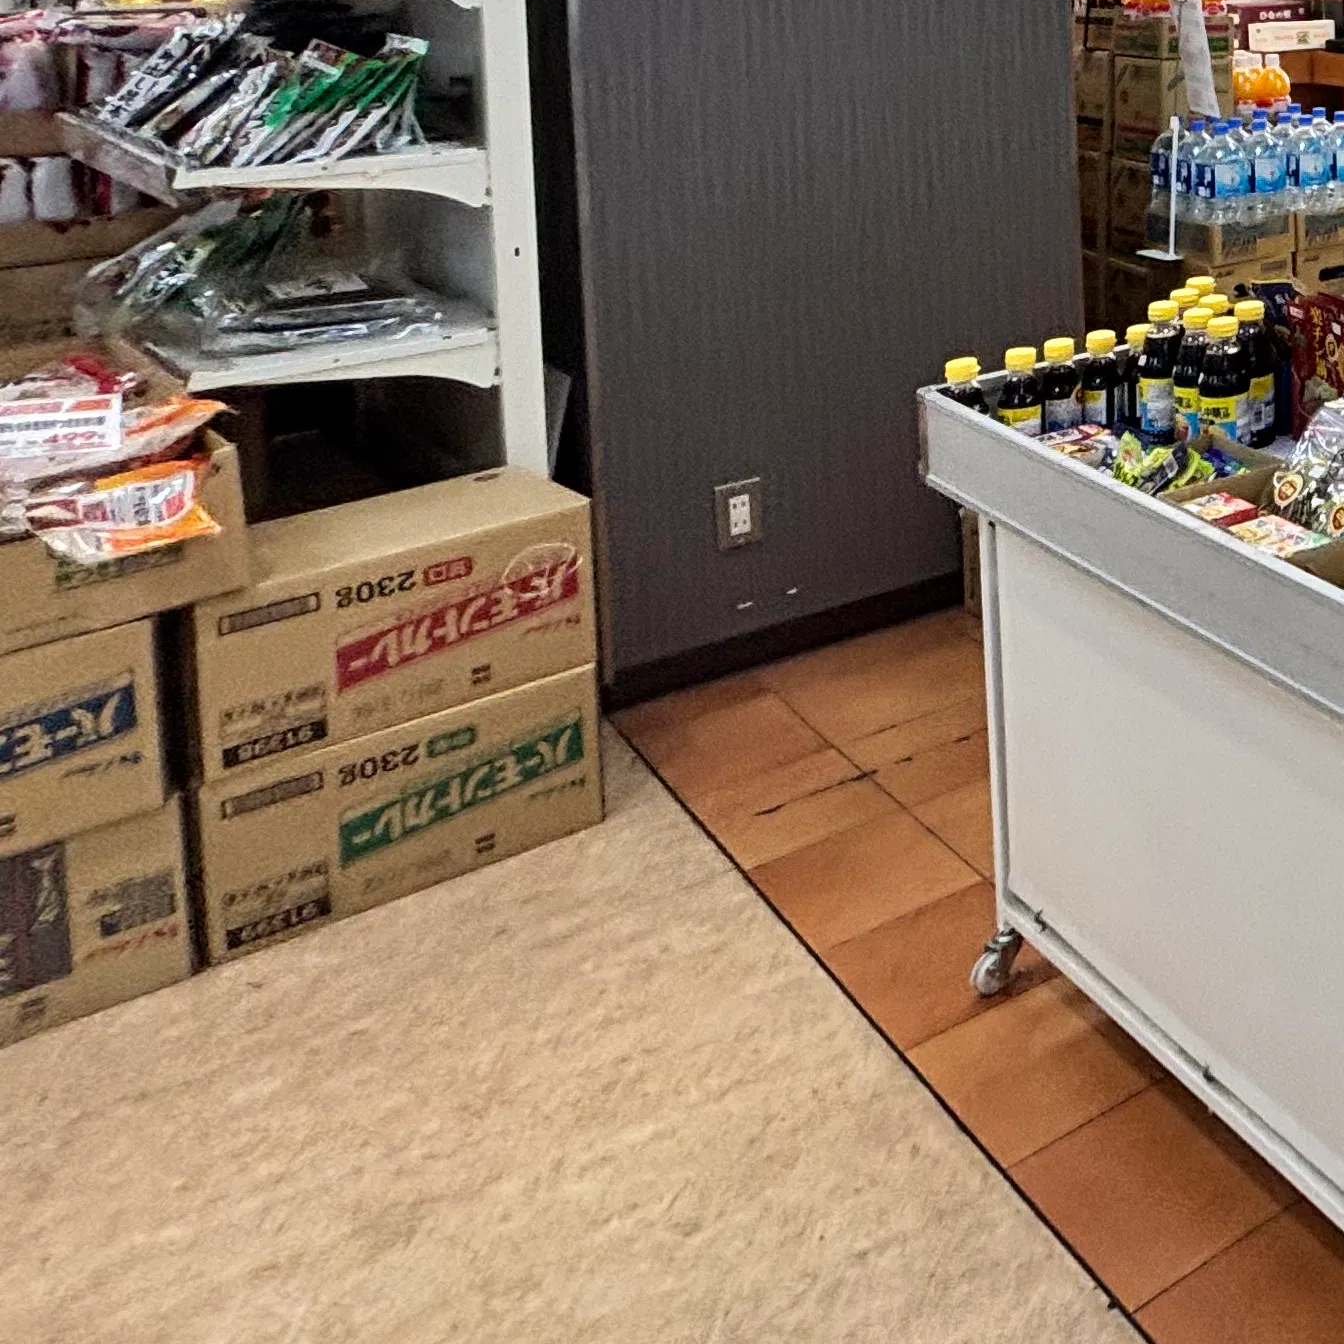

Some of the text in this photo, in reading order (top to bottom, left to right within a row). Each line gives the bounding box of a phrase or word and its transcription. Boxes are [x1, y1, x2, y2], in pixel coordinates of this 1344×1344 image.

[335, 569, 416, 609] 230g
[348, 559, 573, 671] バーモントカレー
[0, 690, 124, 778] バーモ
[338, 744, 420, 788] 230g
[352, 725, 575, 843] バーモントカレー
